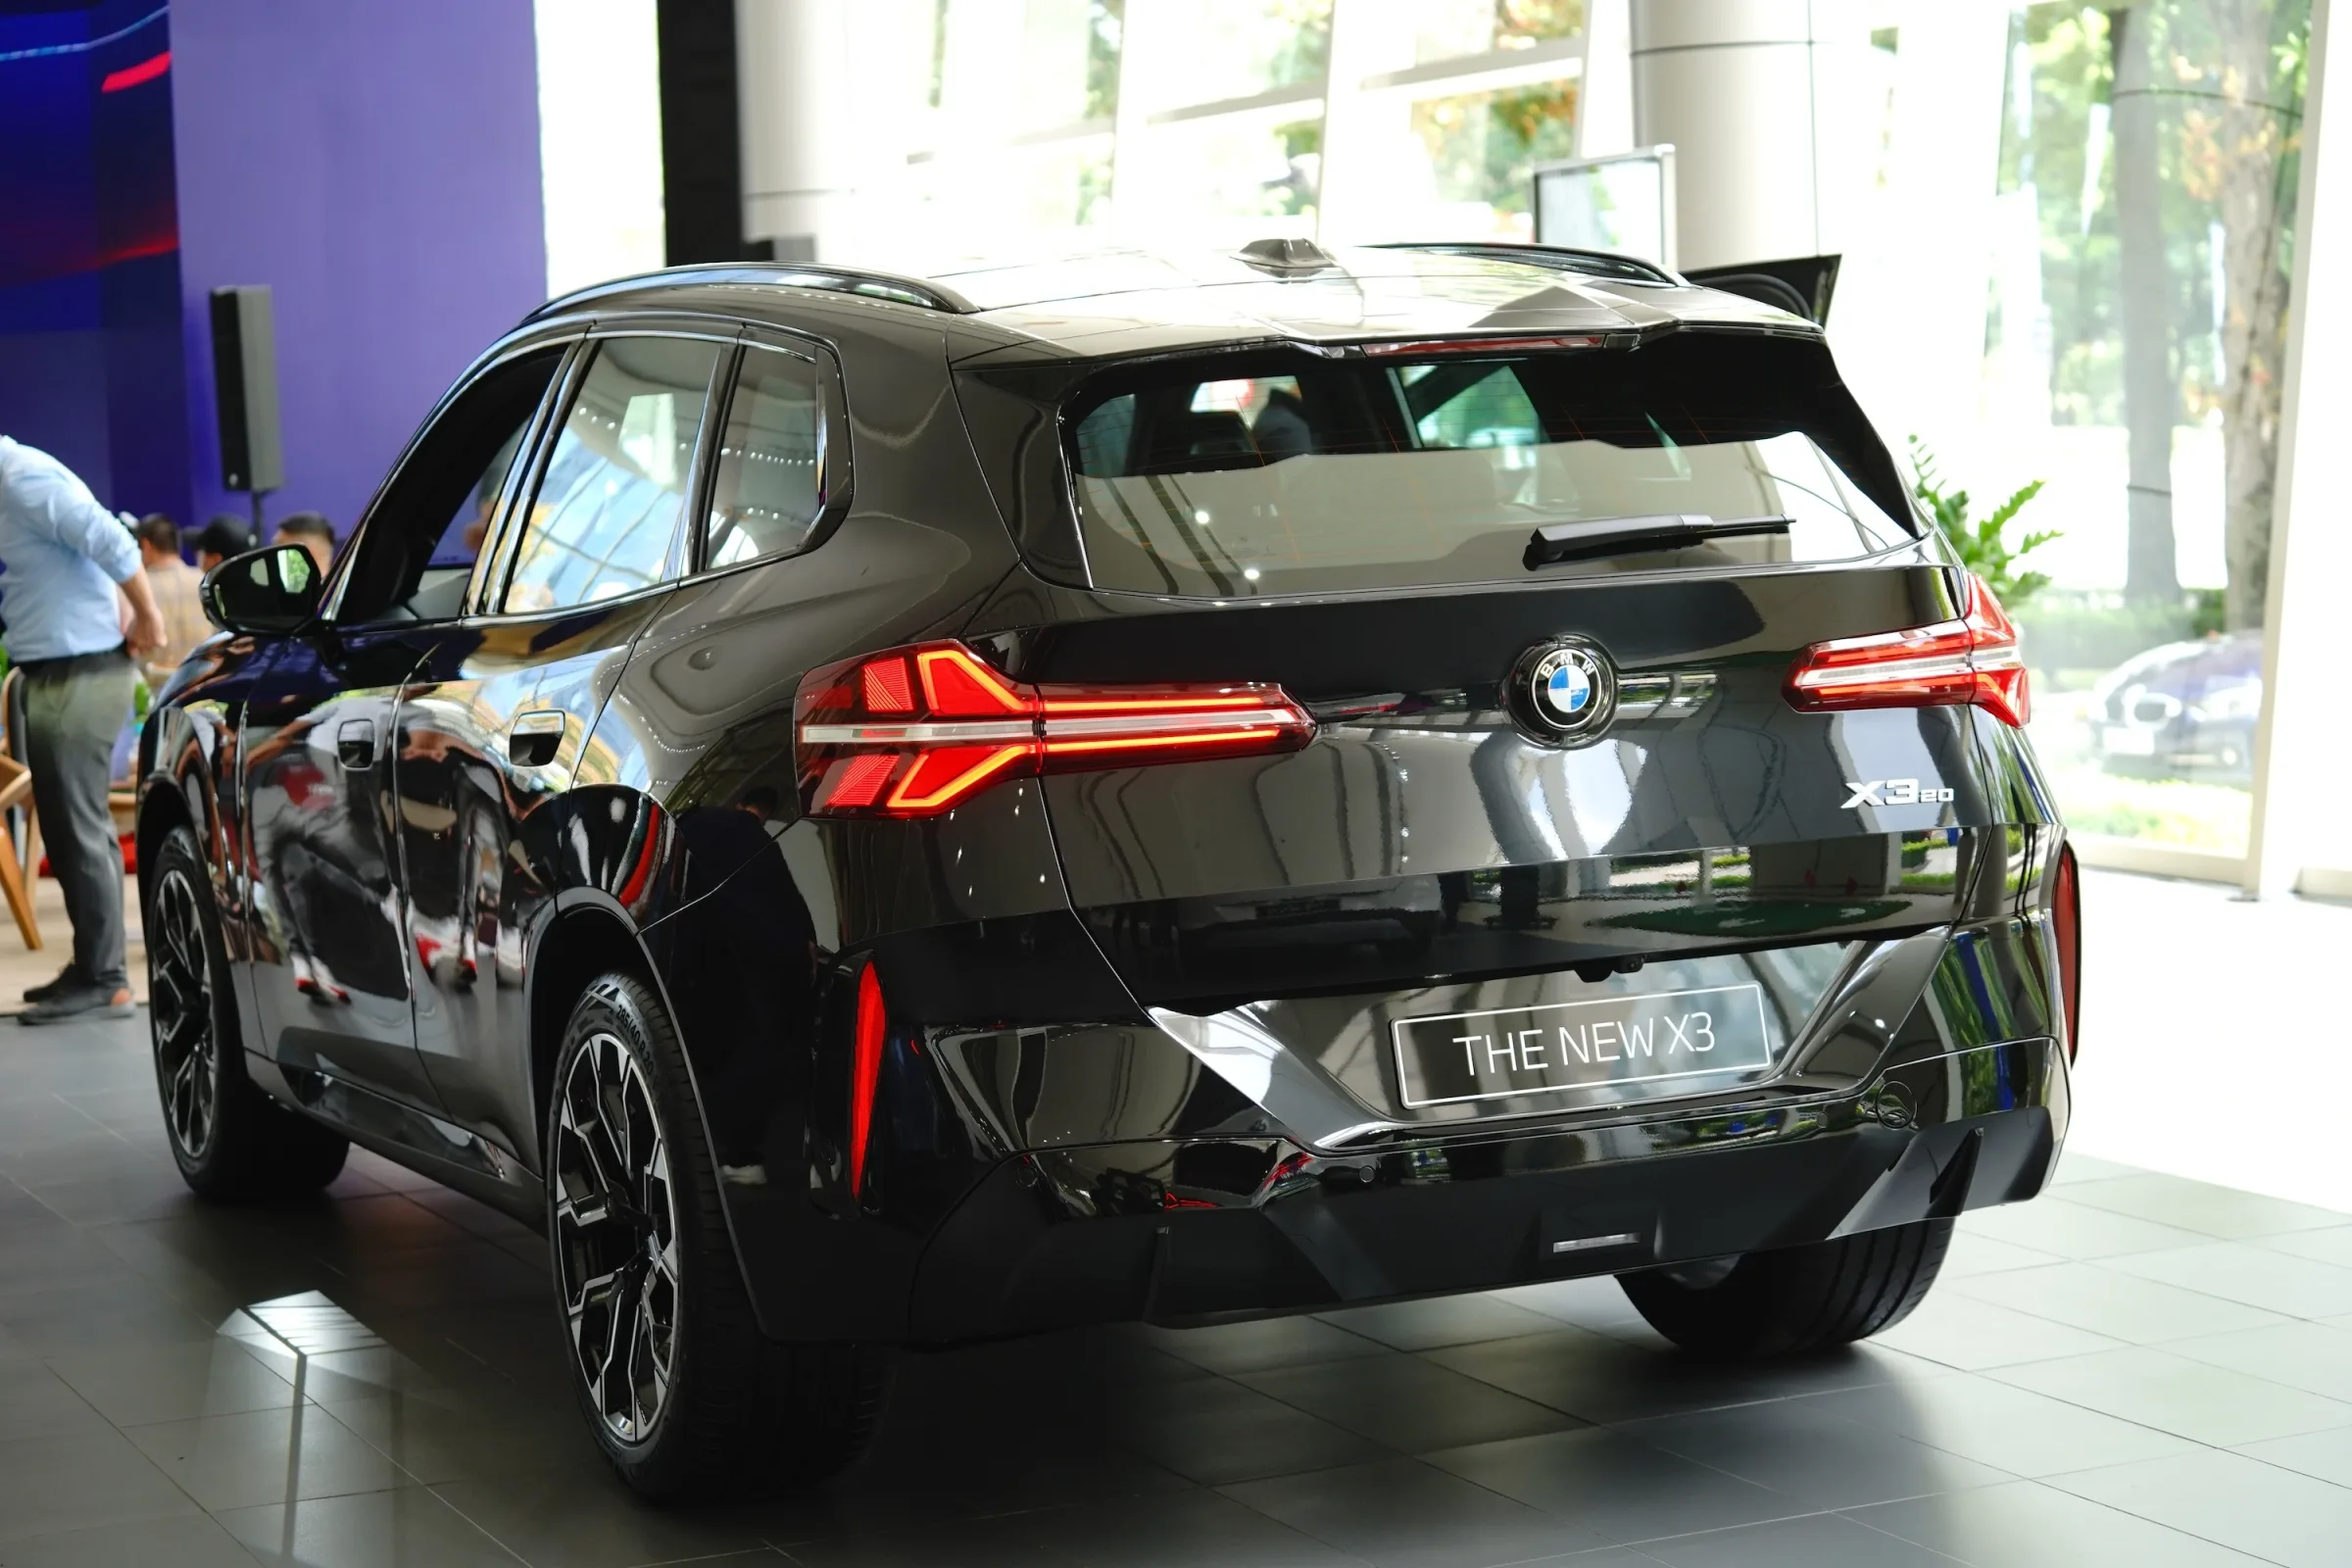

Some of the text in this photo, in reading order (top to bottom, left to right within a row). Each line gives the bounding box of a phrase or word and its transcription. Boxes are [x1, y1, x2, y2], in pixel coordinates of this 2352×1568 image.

[1540, 651, 1595, 679] BMW
[616, 1004, 641, 1045] 285/40
[1452, 1011, 1715, 1076] THE NEW X3
